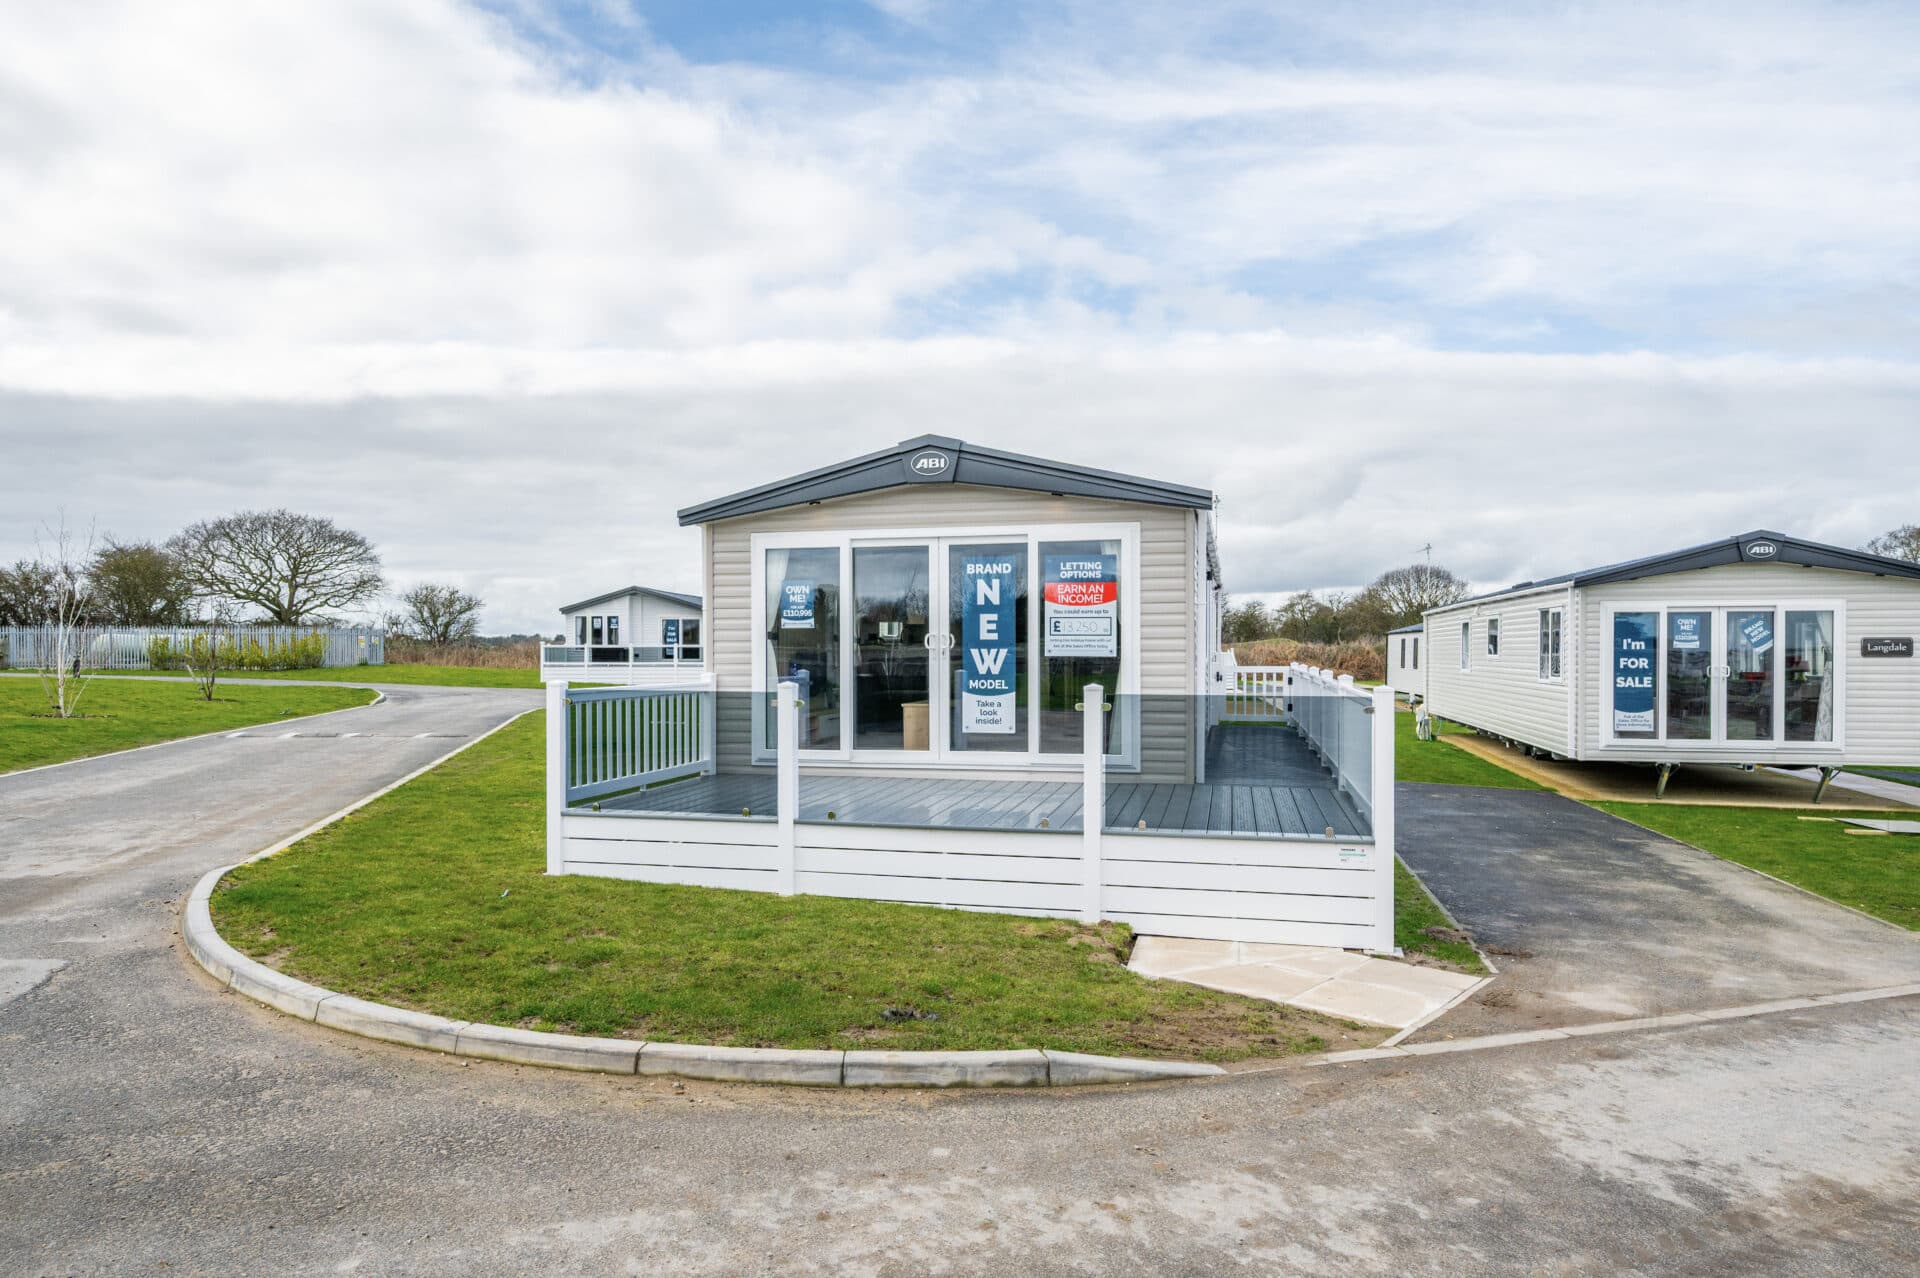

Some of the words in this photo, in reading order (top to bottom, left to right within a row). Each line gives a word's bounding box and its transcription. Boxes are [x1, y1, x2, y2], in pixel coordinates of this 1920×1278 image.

[916, 458, 945, 468] ABI
[966, 563, 1012, 574] BRAND
[1060, 561, 1103, 570] LETTING
[1060, 570, 1102, 579] OPTIONS
[785, 585, 810, 594] OWN
[1057, 584, 1087, 594] EARN
[1088, 584, 1104, 594] AN
[790, 594, 806, 603] ME!
[1058, 594, 1103, 604] INCOME!
[970, 578, 1009, 675] NEW
[1623, 638, 1645, 650] I'm
[1867, 643, 1907, 654] Langdale
[1619, 657, 1649, 669] FOR
[969, 680, 1009, 690] MODEL
[1616, 676, 1652, 688] SALE
[975, 700, 995, 708] Take
[980, 709, 998, 717] look
[975, 716, 1002, 725] inside!
